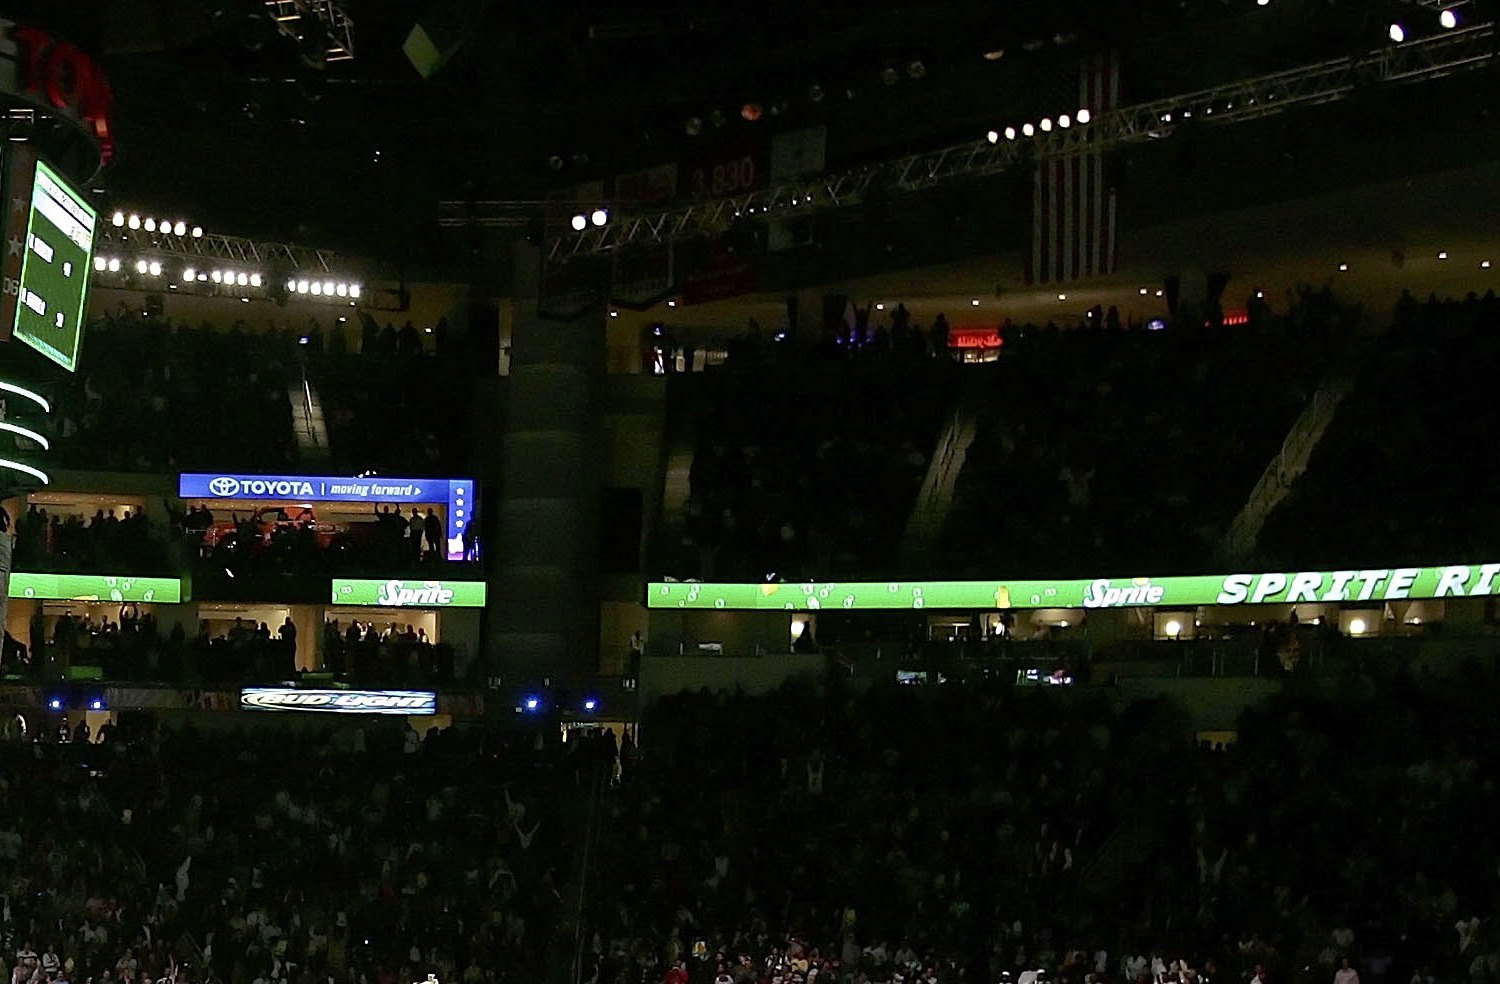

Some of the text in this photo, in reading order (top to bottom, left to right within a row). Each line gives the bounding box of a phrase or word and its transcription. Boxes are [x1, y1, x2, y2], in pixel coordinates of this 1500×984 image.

[240, 481, 413, 498] TOYOTA moving forward
[379, 579, 453, 607] Sprite
[1083, 578, 1164, 608] Sprite
[1216, 568, 1422, 605] SPRITE
